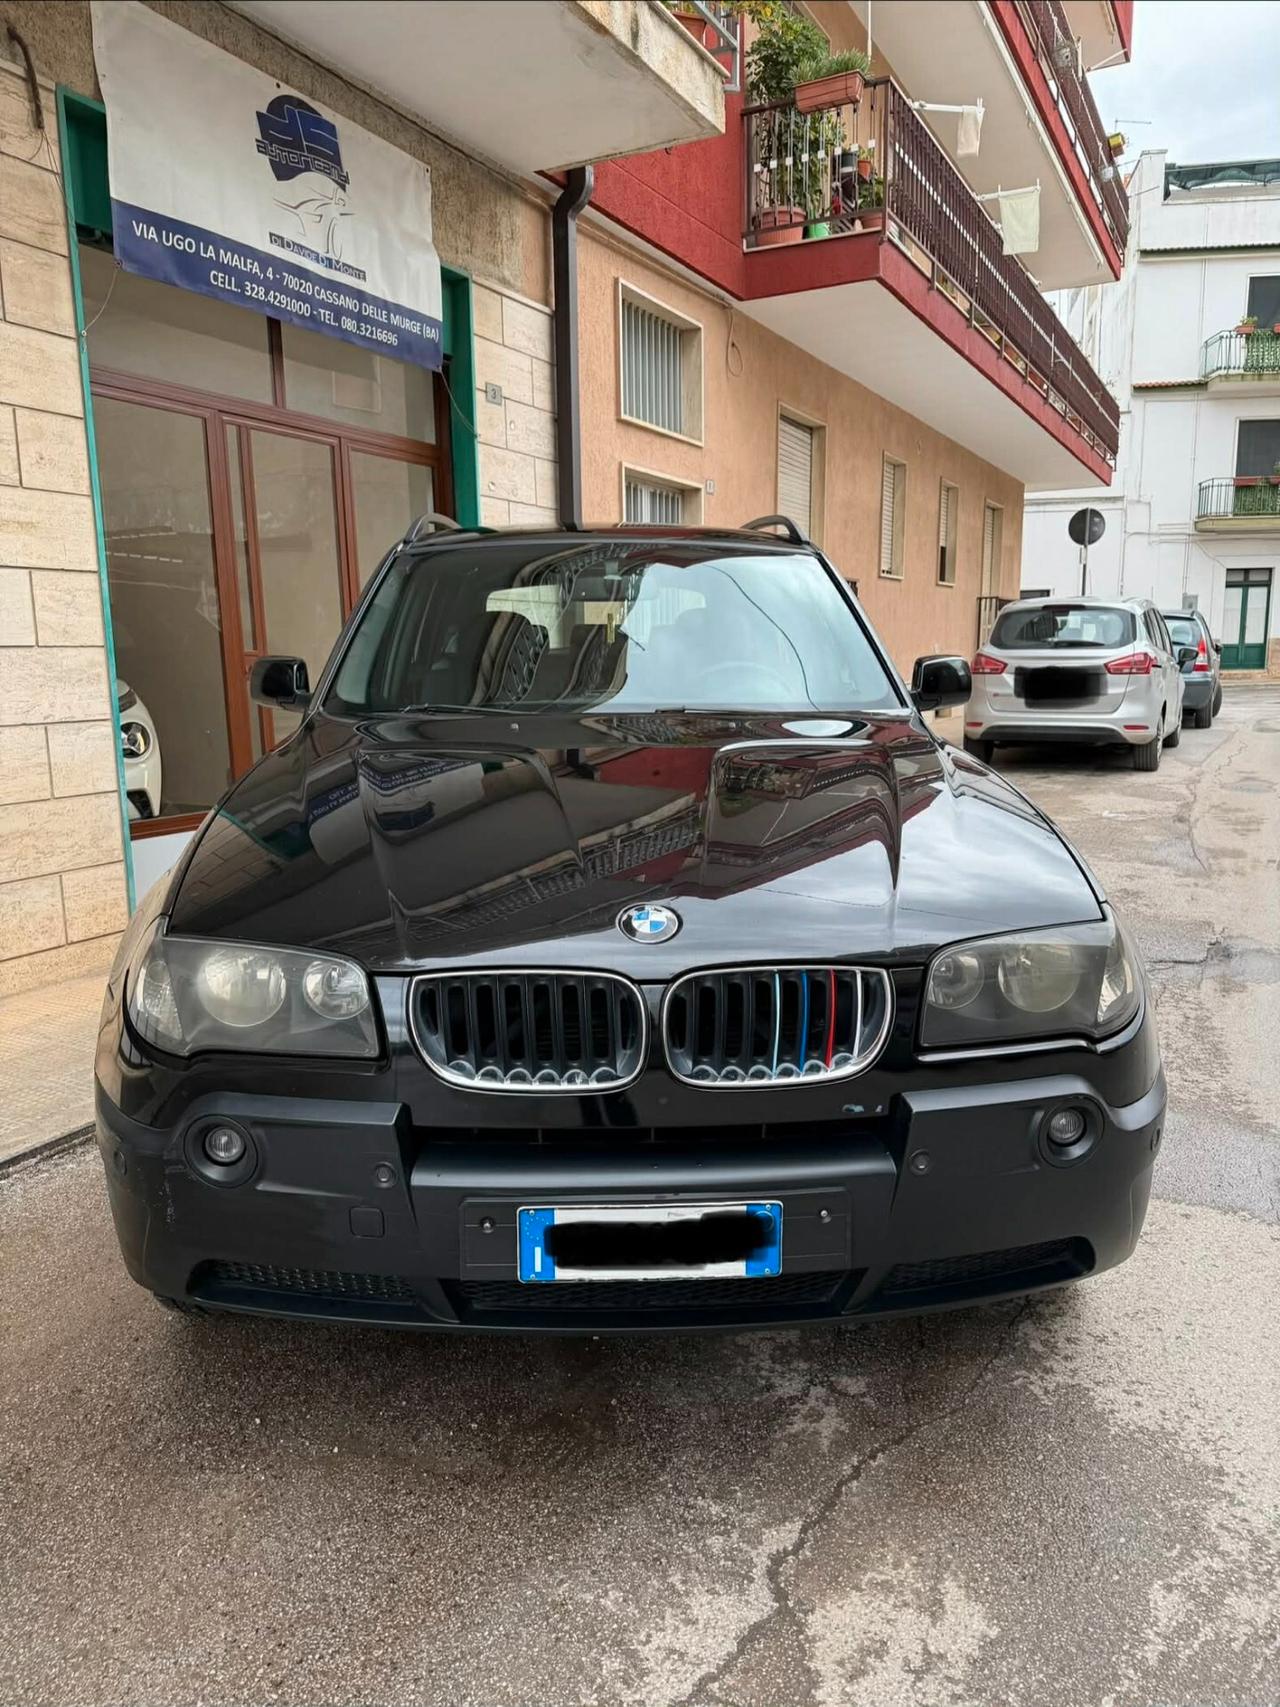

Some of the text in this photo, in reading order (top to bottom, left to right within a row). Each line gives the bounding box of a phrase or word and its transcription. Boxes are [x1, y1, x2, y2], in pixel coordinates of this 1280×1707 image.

[132, 220, 158, 243] VIA
[162, 230, 196, 253] UGO
[200, 242, 216, 261] LA
[219, 249, 264, 280] MALFA,
[266, 266, 273, 281] 4
[282, 272, 313, 295] 70020
[314, 285, 360, 313] CASSANO
[362, 303, 388, 323] DELLE
[390, 313, 425, 334] MURGE
[423, 323, 439, 343] (BA)
[210, 270, 241, 293] CELL.
[244, 281, 311, 317] 328.4291000
[318, 308, 339, 327] TEL.
[341, 316, 398, 346] 080.3216696
